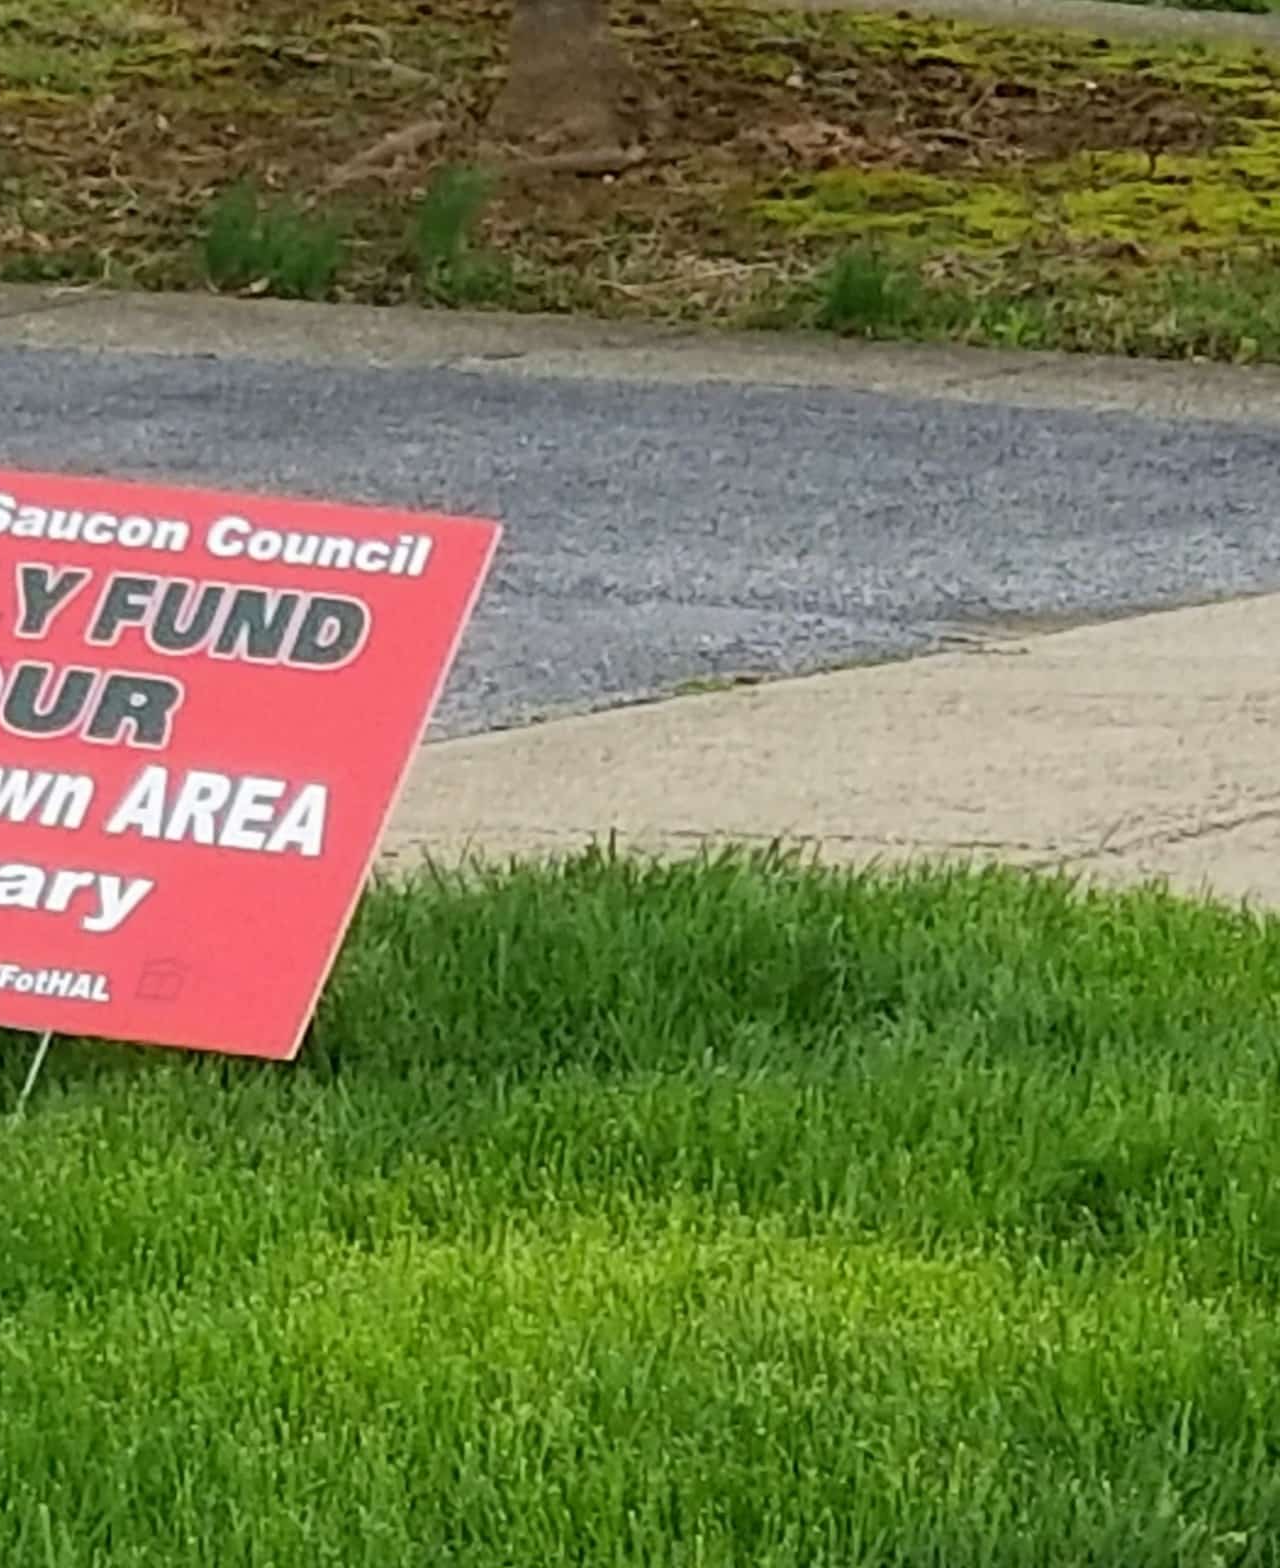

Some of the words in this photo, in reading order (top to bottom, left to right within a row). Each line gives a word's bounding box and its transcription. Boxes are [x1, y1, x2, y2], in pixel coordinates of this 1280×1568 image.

[206, 517, 431, 575] Council
[90, 573, 368, 668] FUND
[108, 766, 327, 855] AREA
